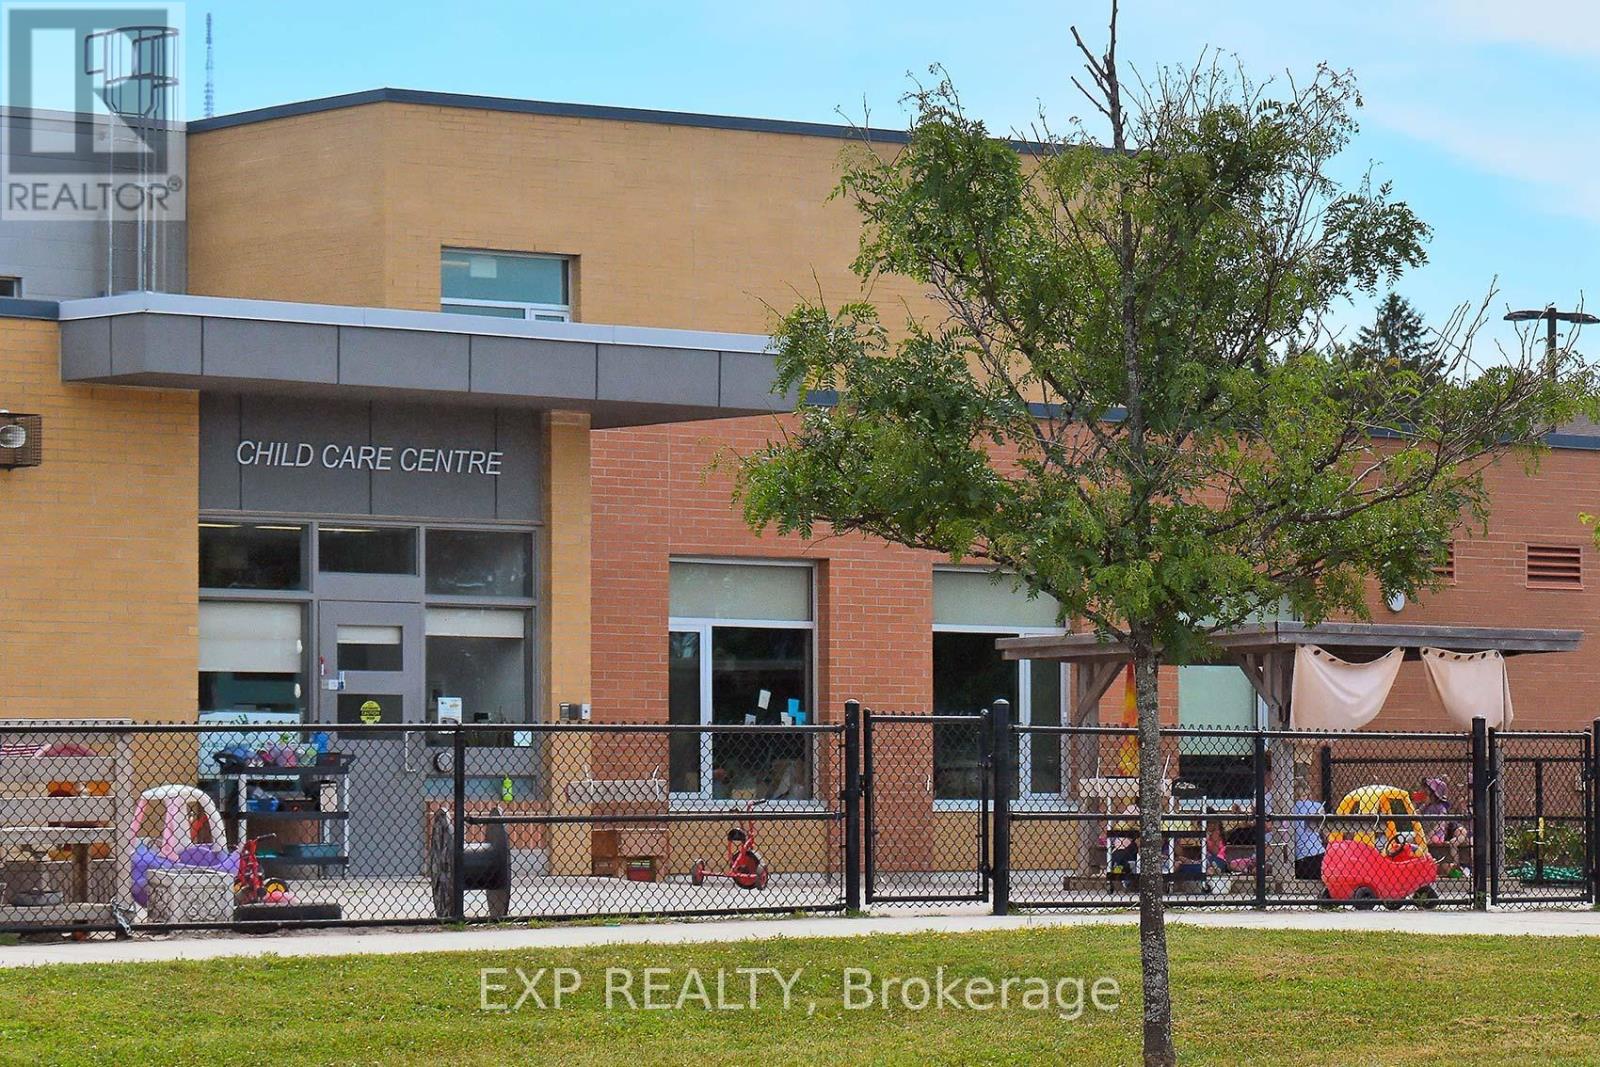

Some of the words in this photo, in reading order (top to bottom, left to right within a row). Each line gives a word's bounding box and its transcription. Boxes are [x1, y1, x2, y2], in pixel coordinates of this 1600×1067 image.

[236, 440, 315, 467] CHILD
[322, 444, 394, 471] CARE
[400, 447, 504, 475] CENTRE
